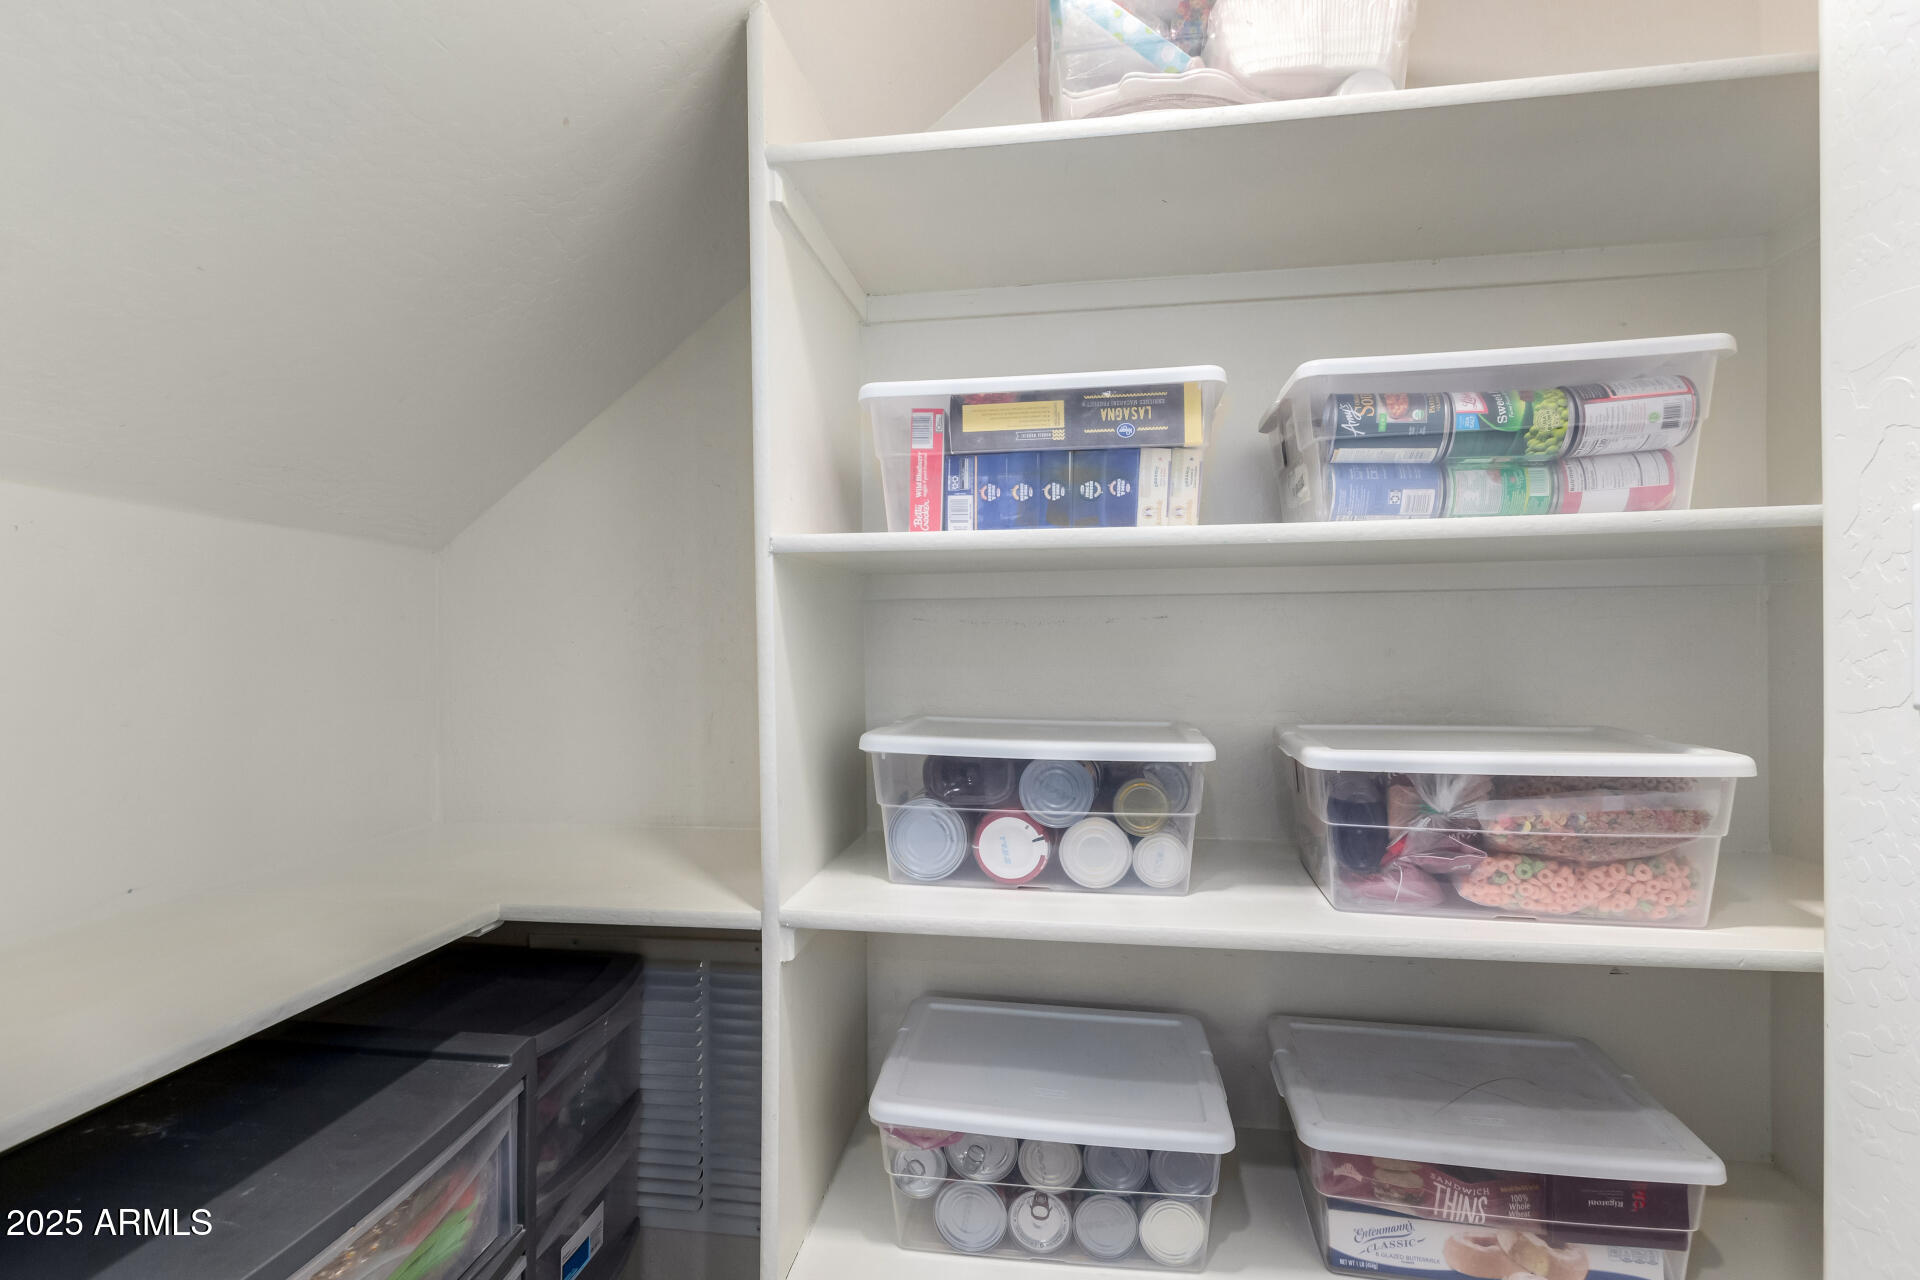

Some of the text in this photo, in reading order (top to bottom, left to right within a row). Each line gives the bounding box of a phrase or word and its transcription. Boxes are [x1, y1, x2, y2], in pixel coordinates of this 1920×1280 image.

[1100, 406, 1152, 421] LASAGNA
[1495, 393, 1508, 424] Sweet
[1340, 402, 1366, 437] Amy's
[915, 482, 923, 498] Wild
[913, 504, 924, 528] Betty
[1430, 1173, 1490, 1195] SANDWICH
[1433, 1181, 1488, 1224] THINS
[1510, 1193, 1528, 1203] 100%
[1588, 1199, 1624, 1209] Rigatoni
[1508, 1210, 1531, 1218] Wheat
[1509, 1202, 1531, 1211] Whole
[1366, 1239, 1416, 1253] CLASSIC
